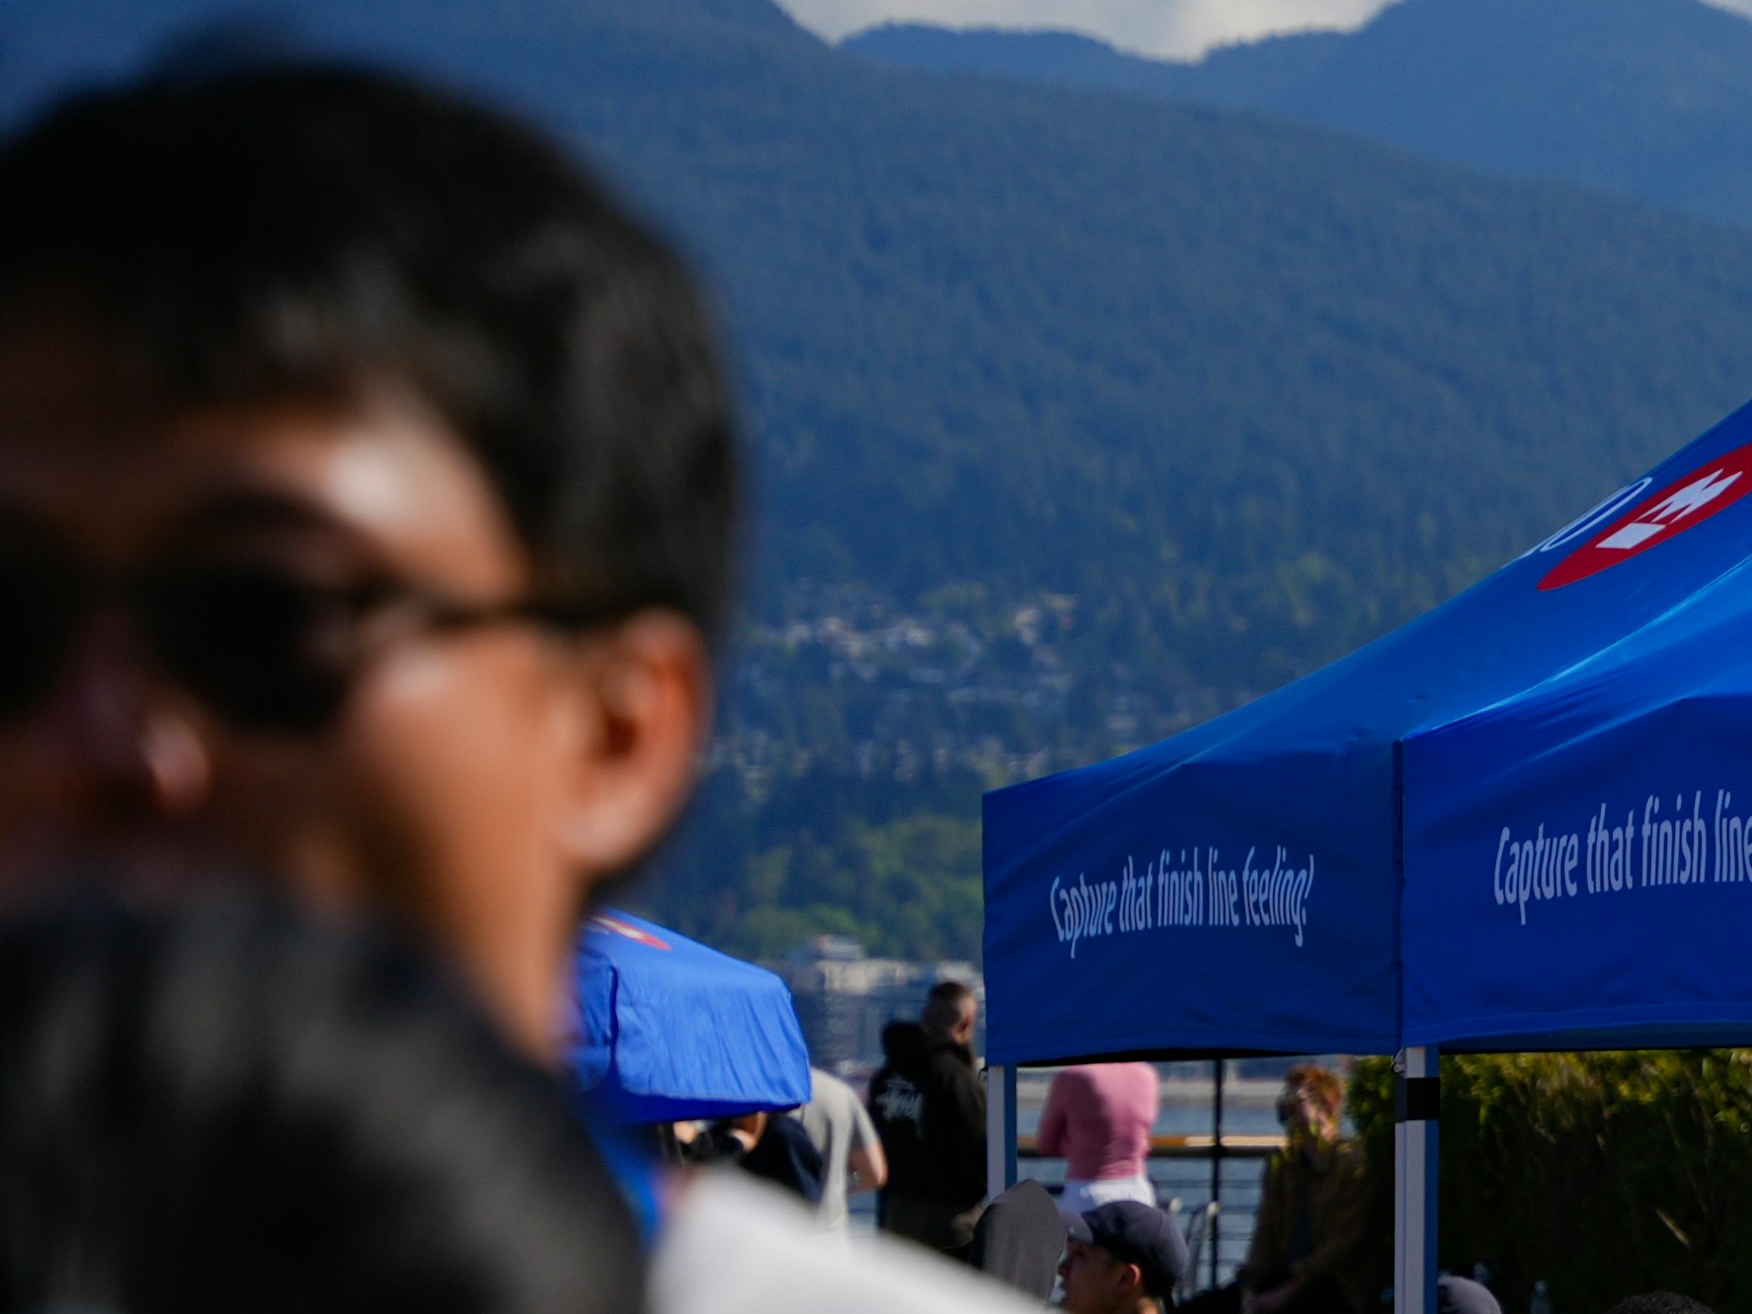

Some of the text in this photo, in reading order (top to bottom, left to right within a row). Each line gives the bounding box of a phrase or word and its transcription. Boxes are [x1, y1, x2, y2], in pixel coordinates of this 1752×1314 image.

[1050, 844, 1315, 960] Capture that finish line feeling!
[1494, 825, 1579, 926] Capture
[1586, 802, 1634, 895] that
[1641, 790, 1707, 887] finish
